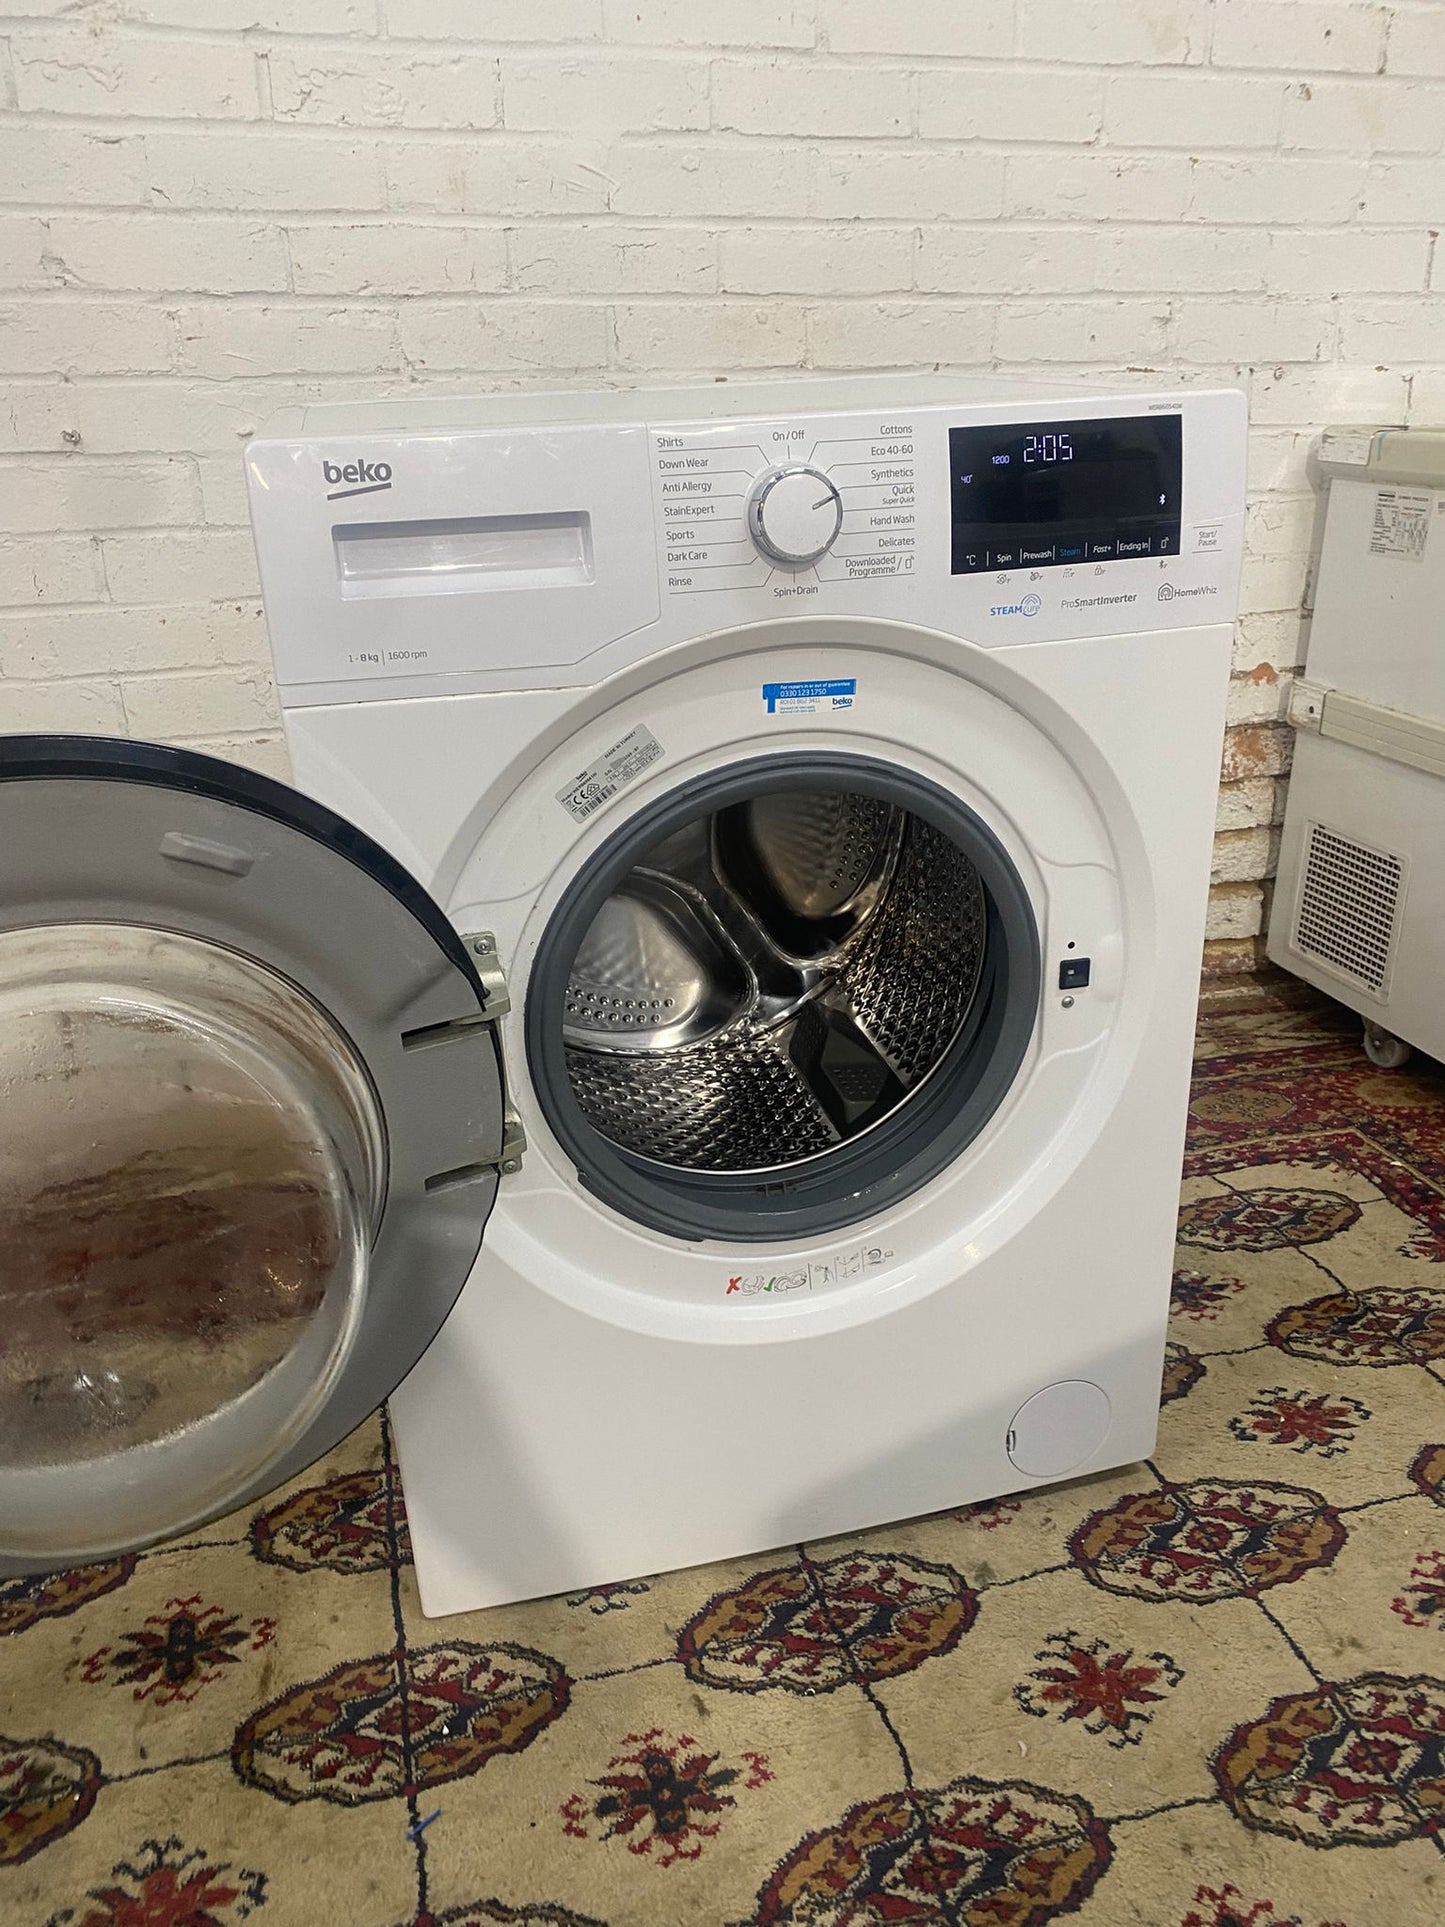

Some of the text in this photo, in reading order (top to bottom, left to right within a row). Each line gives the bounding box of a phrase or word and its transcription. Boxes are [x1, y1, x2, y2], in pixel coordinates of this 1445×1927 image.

[772, 431, 785, 441] On
[791, 430, 805, 440] Off
[880, 425, 913, 435] Cottons
[657, 437, 684, 447] Shirts
[871, 444, 913, 456] Eco 40-60
[1023, 434, 1073, 462] 2:05
[659, 458, 709, 470] Down Wear
[991, 454, 1010, 465] 1200
[322, 459, 393, 484] beko
[871, 468, 914, 481] Synthetics
[662, 481, 712, 492] Anti Allergy
[892, 485, 915, 496] Quick
[882, 496, 915, 505] Super Quick
[664, 505, 715, 517] StainExpert
[870, 514, 915, 526] Hand Wash
[666, 530, 695, 541] Sports
[878, 537, 916, 547] Delicates
[1120, 540, 1149, 552] Ending In
[1198, 538, 1217, 547] Pause
[1023, 550, 1052, 560] Prewash
[1093, 545, 1112, 554] Fast+
[667, 550, 708, 562] Dark Care
[845, 555, 896, 568] Downloaded
[996, 554, 1012, 564] Spin
[849, 566, 896, 578] Programme
[668, 576, 692, 587] Rinse
[773, 585, 819, 598] Spin+Drain
[1174, 585, 1217, 598] HomeWhiz
[1061, 594, 1138, 608] ProSmartInverter
[388, 650, 411, 660] 1600
[410, 651, 428, 660] rpm
[832, 697, 853, 706] beko
